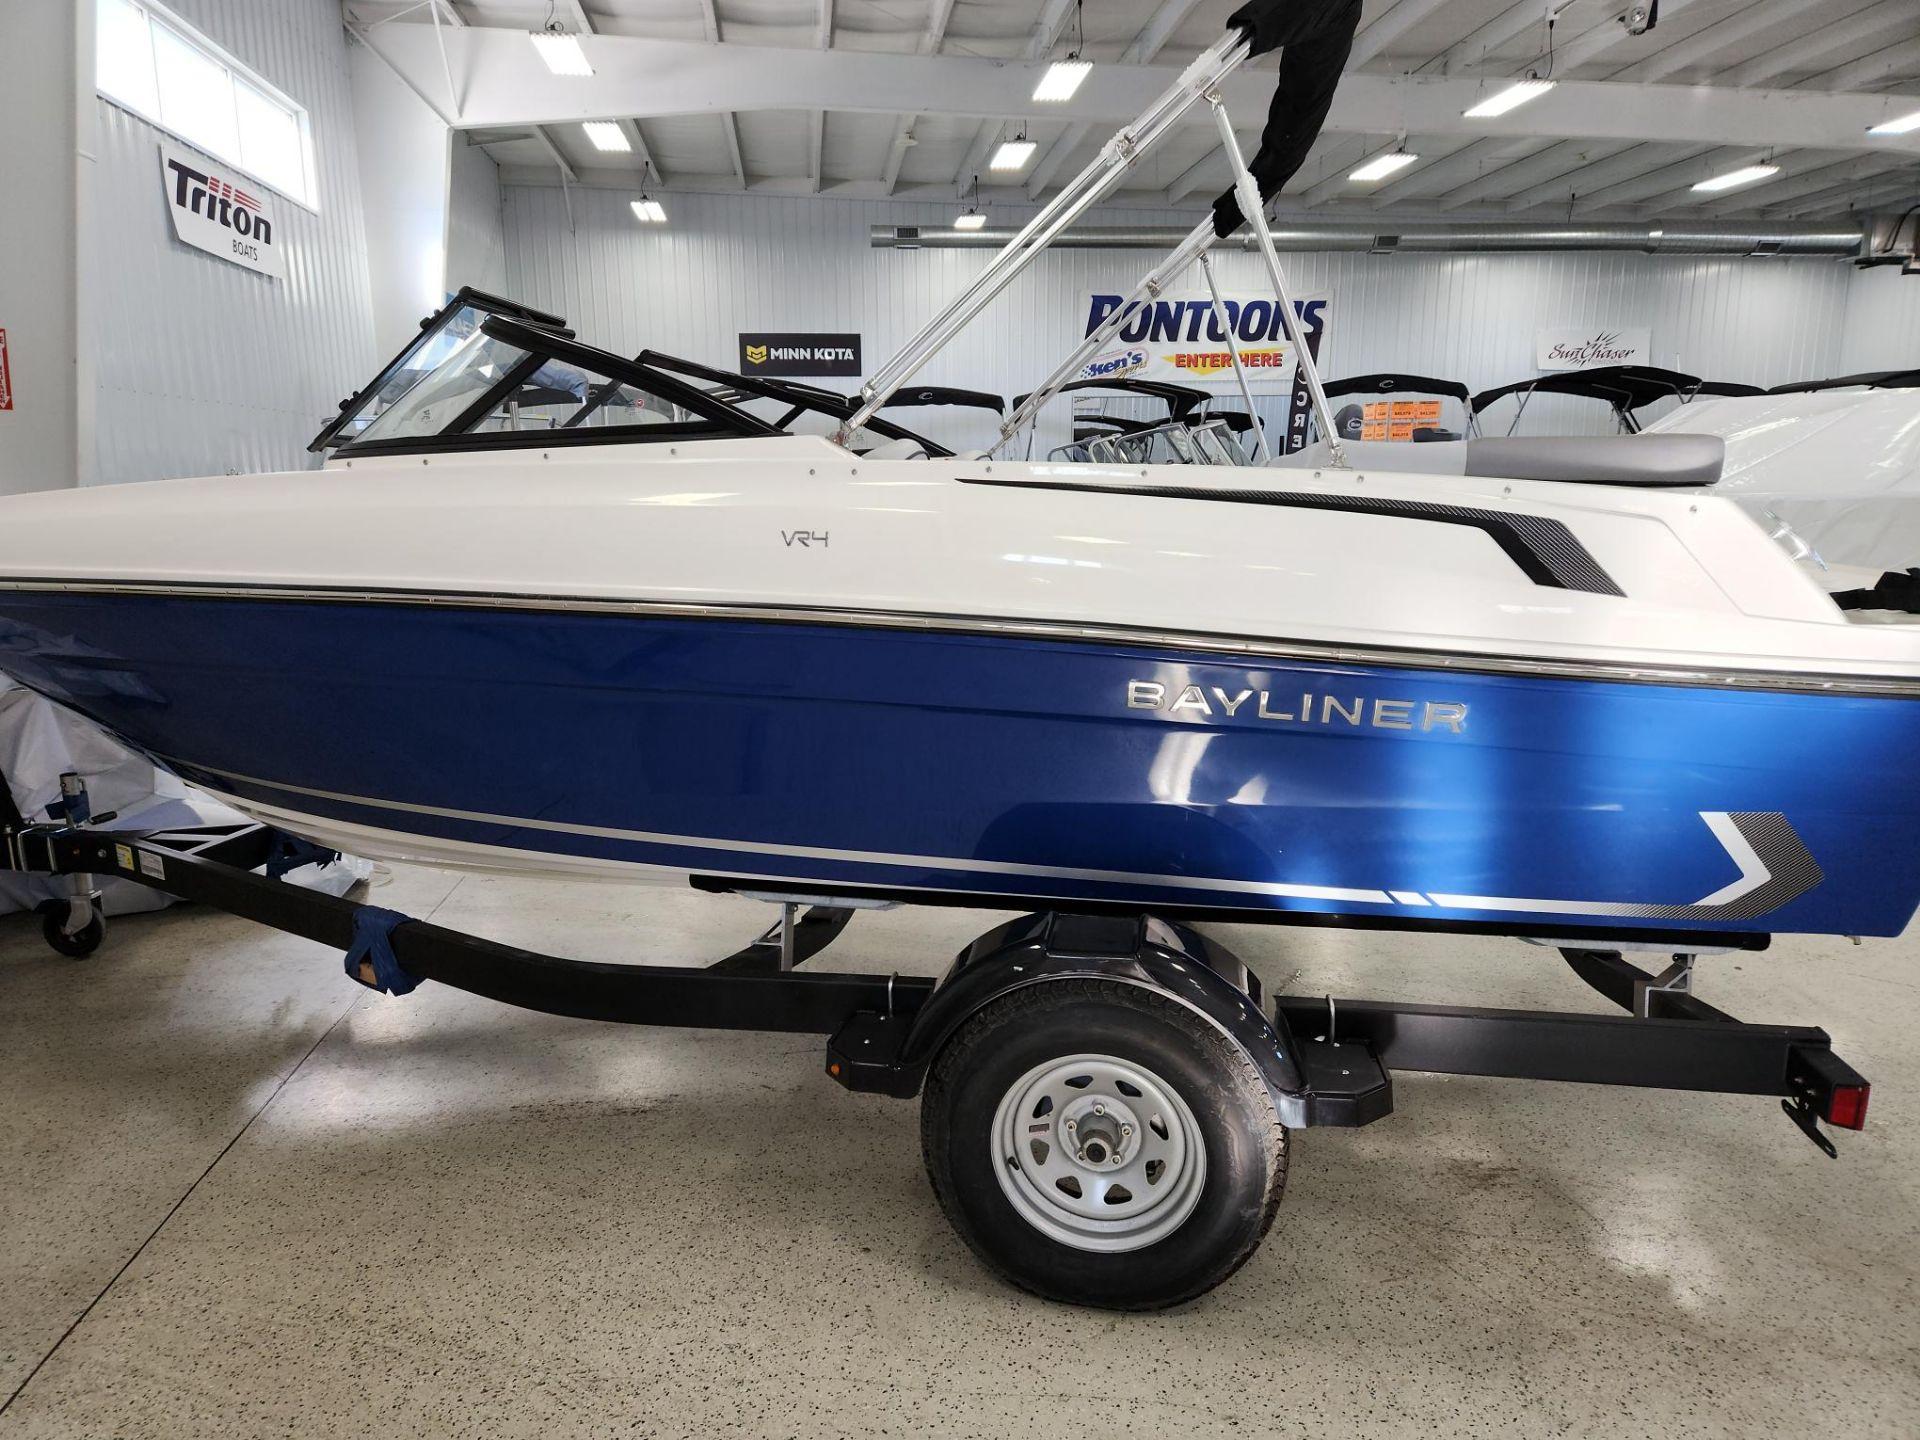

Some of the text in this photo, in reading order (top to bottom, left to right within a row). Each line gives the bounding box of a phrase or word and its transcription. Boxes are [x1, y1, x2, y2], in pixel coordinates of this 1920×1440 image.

[168, 158, 272, 245] Triton
[232, 239, 258, 262] BOATS
[1084, 294, 1327, 343] PONTOONS
[770, 347, 854, 360] MINN KOTA
[1175, 352, 1283, 368] ENTER HERE
[781, 530, 829, 548] VR4
[1127, 679, 1471, 734] BAYLINER
